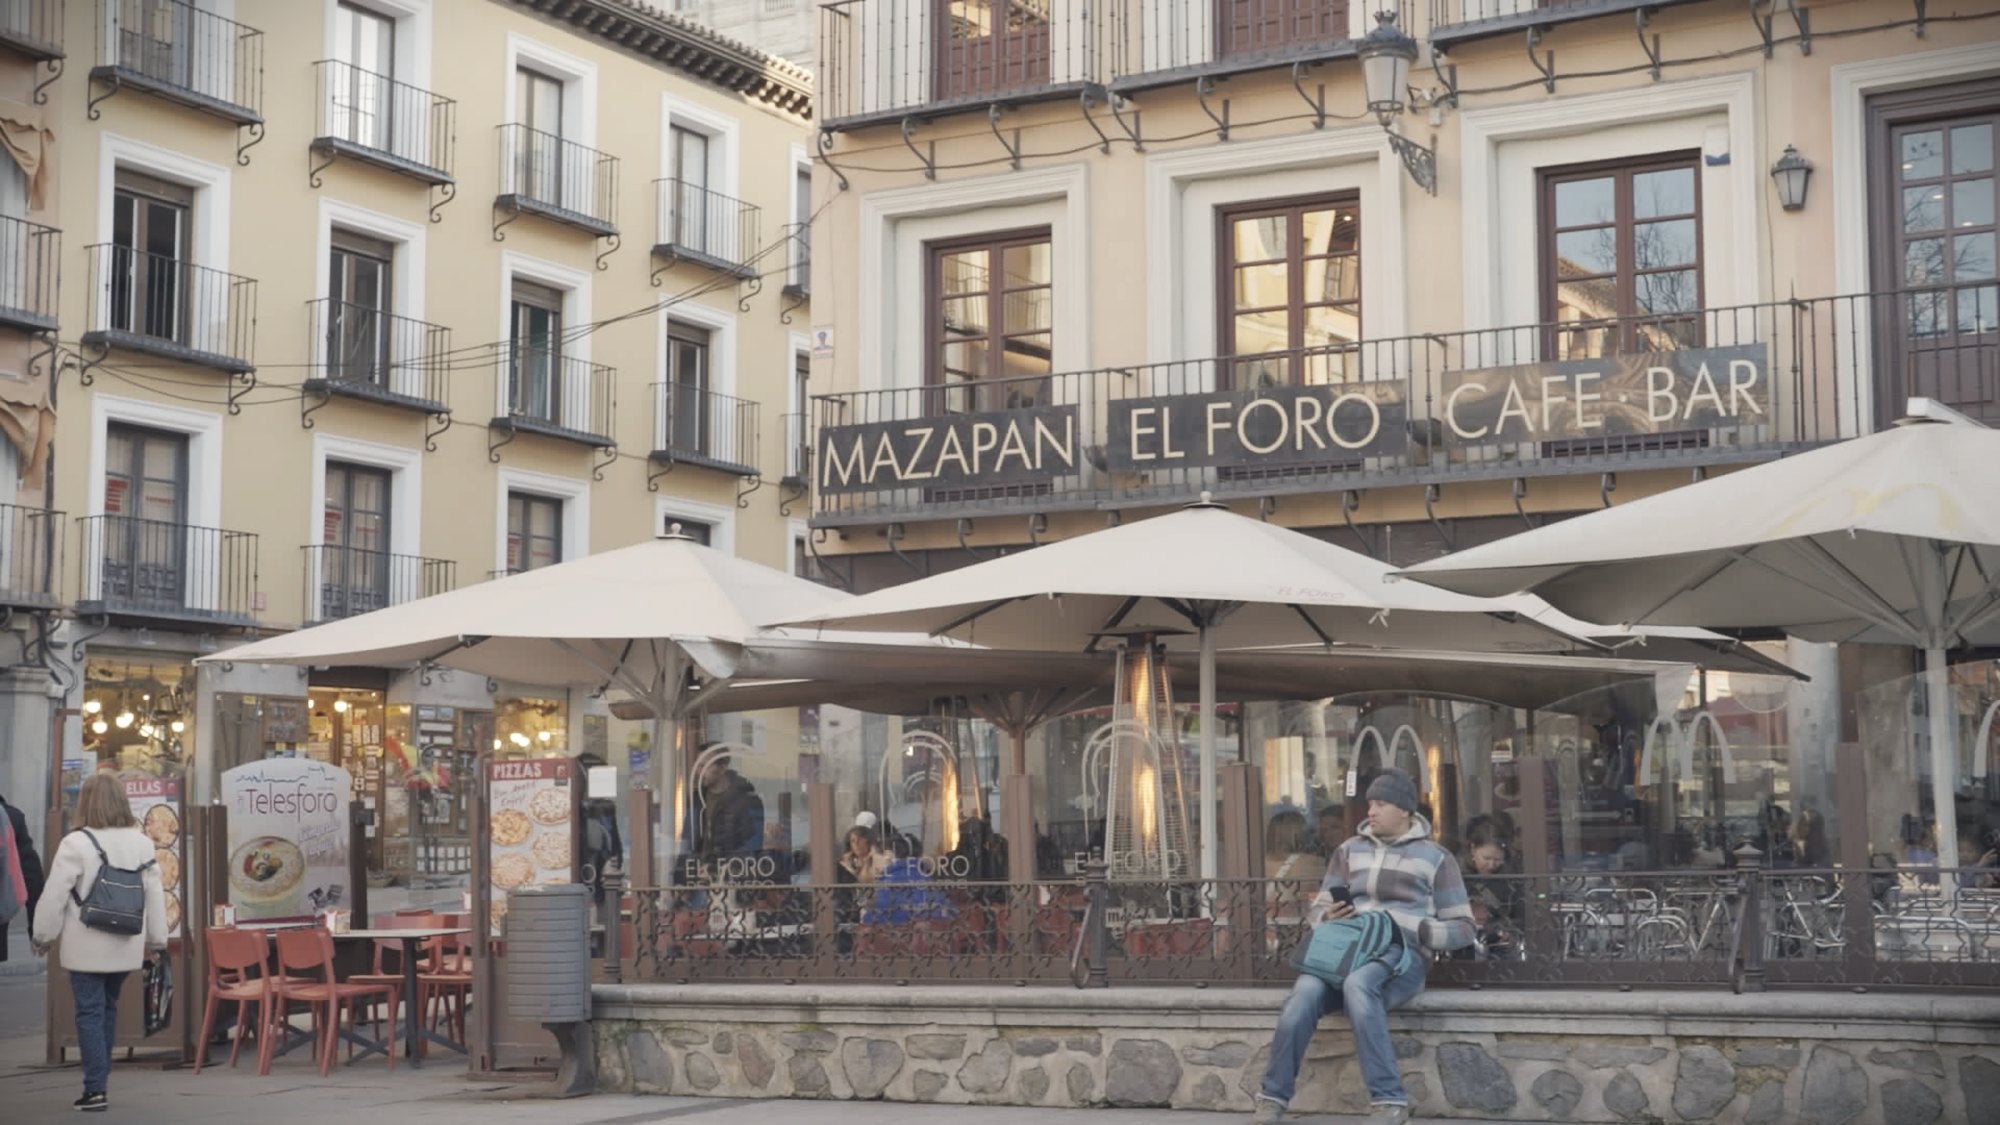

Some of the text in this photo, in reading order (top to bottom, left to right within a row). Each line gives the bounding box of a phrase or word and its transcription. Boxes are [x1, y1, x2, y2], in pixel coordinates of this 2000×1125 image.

[1446, 359, 1763, 439] CAFE BAR
[1130, 392, 1381, 461] EL FORO
[822, 414, 1074, 488] MAZAPAN
[493, 762, 542, 779] PIZZAS
[126, 780, 161, 795] ELLAS
[245, 783, 338, 823] Telesforo
[685, 856, 776, 878] EL FORO
[906, 855, 969, 877] FORO
